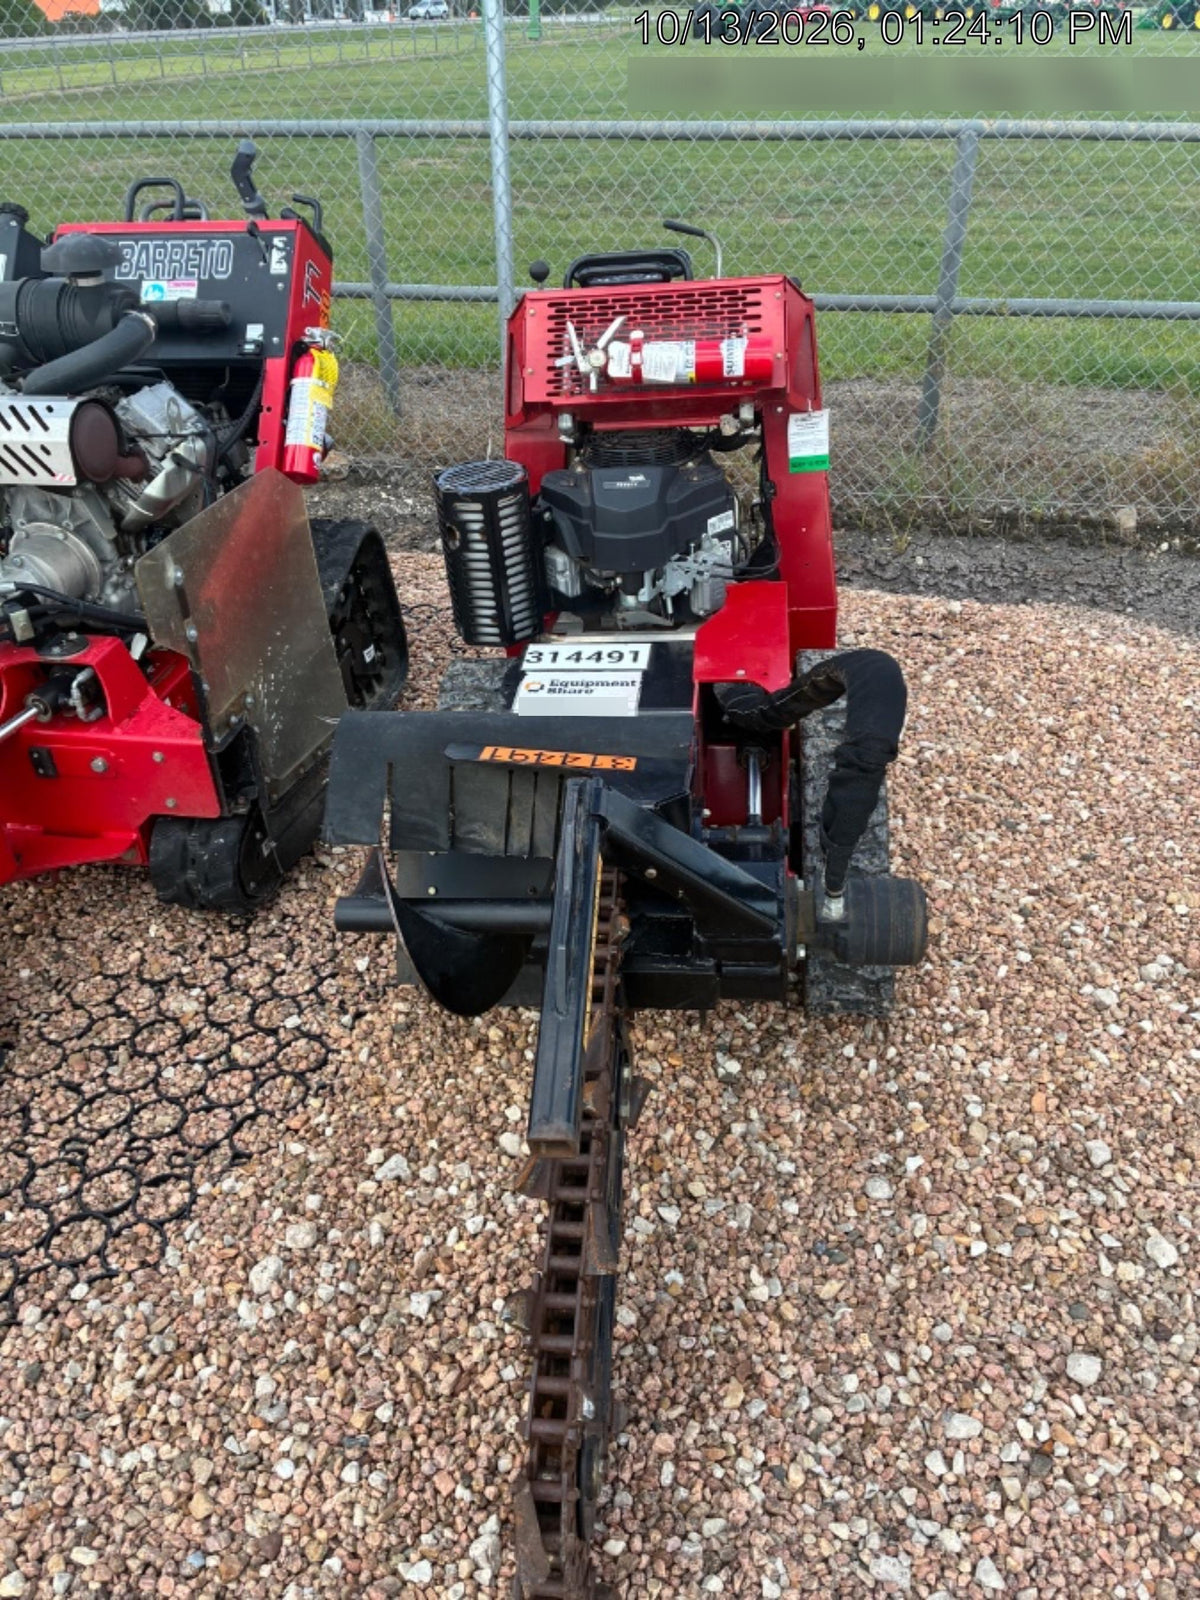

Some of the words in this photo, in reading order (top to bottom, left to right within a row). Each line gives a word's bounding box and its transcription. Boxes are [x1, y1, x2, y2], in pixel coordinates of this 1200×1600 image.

[115, 239, 234, 280] BARRETO
[525, 650, 640, 664] 314491
[549, 679, 637, 689] Equipment
[489, 747, 633, 769] 314491
